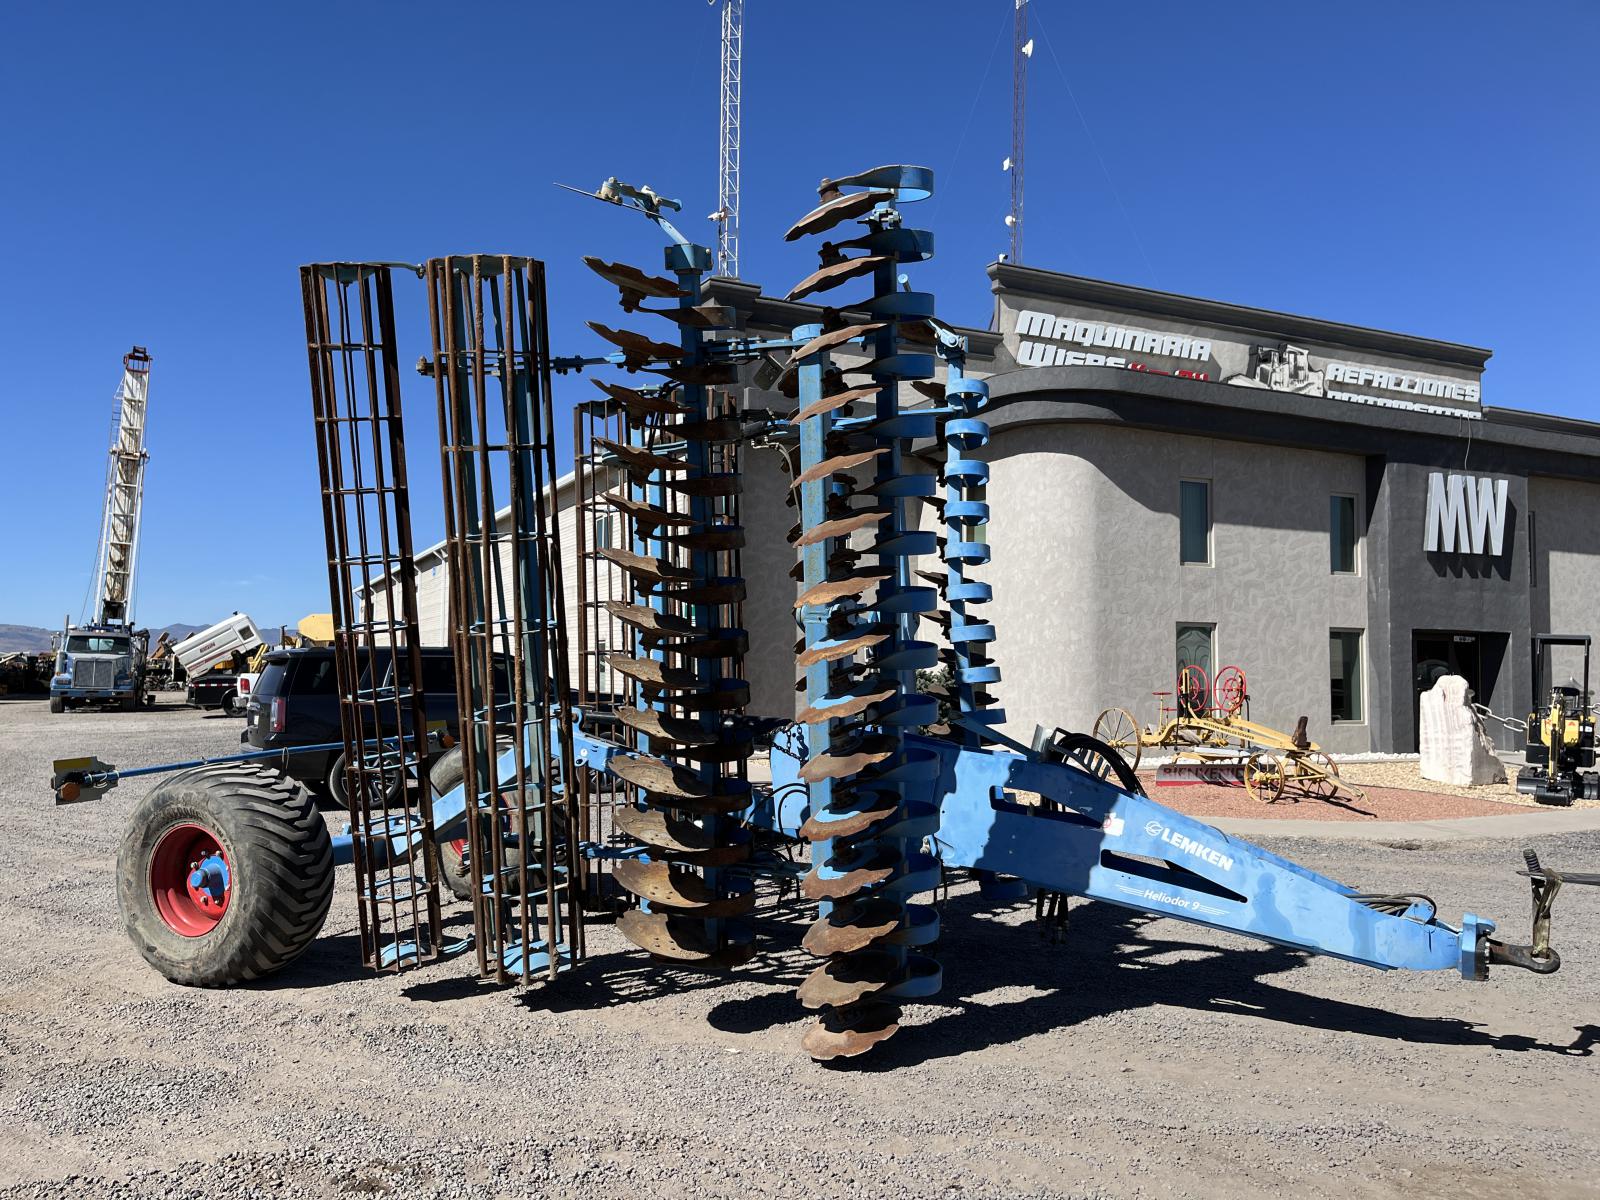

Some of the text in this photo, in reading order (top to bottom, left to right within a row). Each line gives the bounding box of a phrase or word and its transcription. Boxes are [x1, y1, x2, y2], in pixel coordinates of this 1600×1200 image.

[1015, 309, 1211, 361] MAQUINARIA
[1325, 362, 1481, 403] REFACCIONES
[1423, 472, 1509, 556] MW
[1161, 827, 1234, 872] LEMKEN
[1143, 888, 1201, 911] Heliodor 9
